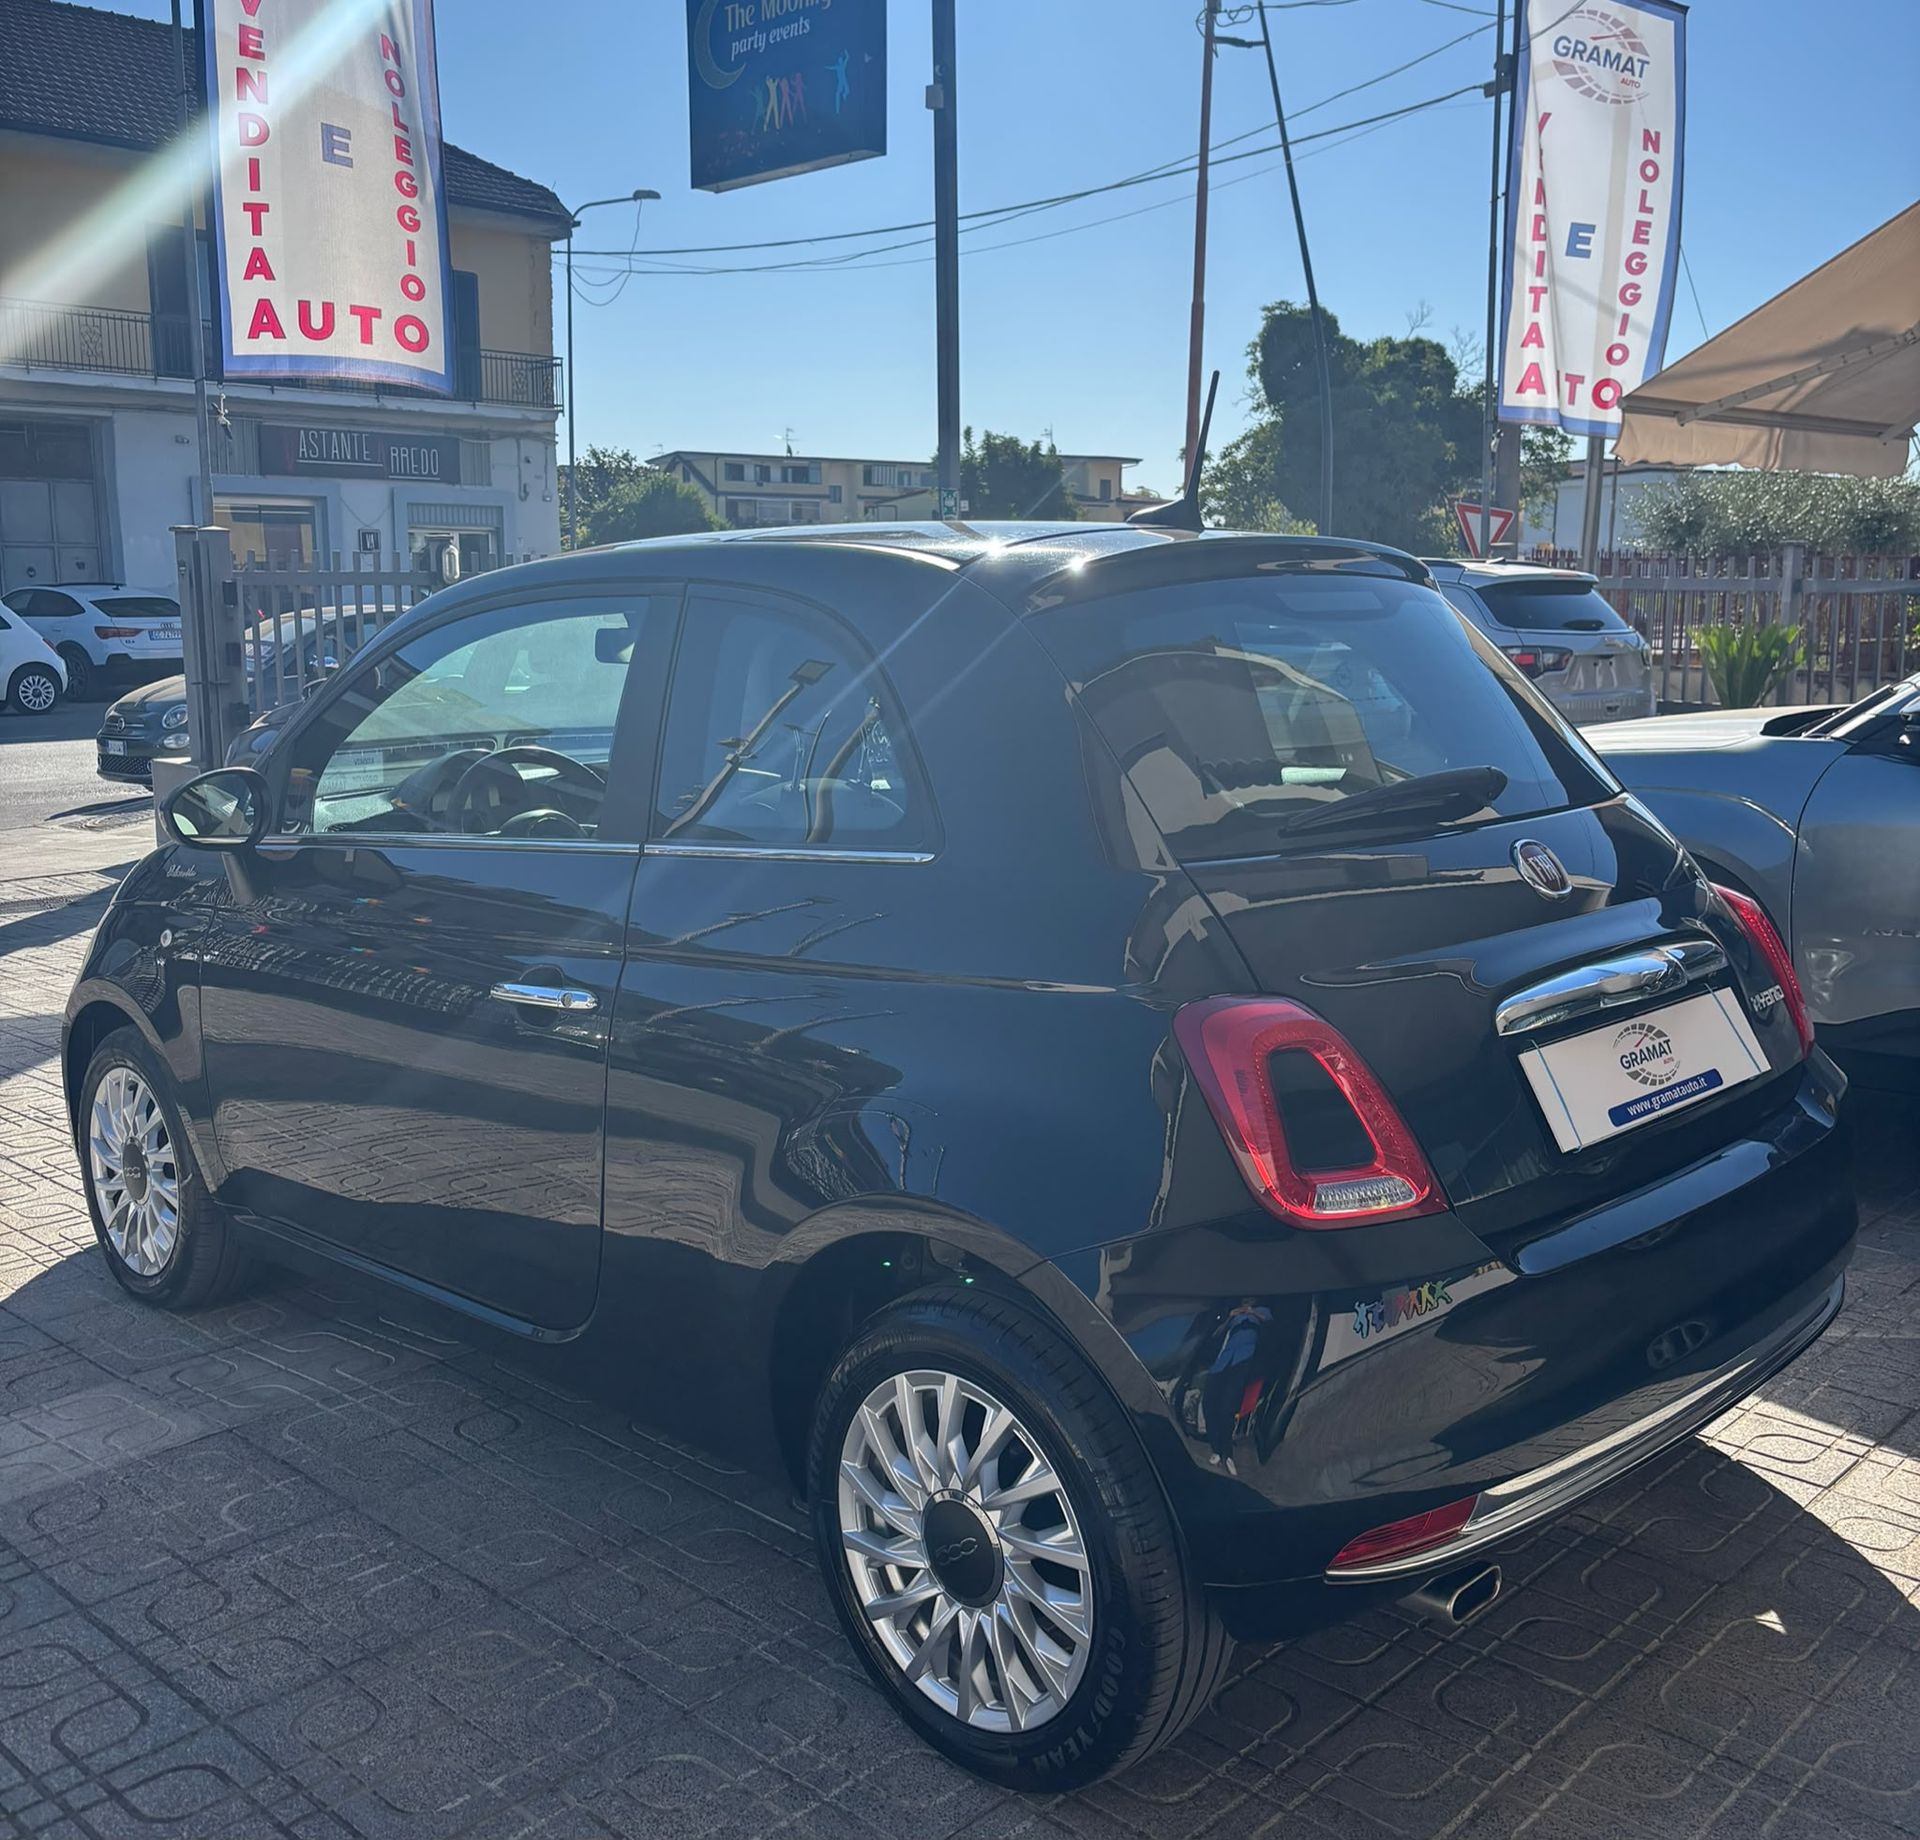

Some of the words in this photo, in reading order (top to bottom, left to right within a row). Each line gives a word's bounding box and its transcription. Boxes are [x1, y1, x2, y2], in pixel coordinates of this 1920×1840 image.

[724, 3, 755, 32] The
[731, 30, 767, 62] party
[769, 16, 811, 44] events
[1553, 35, 1650, 78] GRAMAT
[1620, 77, 1641, 89] AUTO
[320, 122, 353, 168] E
[381, 33, 426, 302] NOLEGGIO
[1565, 222, 1596, 259] E
[1605, 128, 1661, 366] NOLEGGIO
[247, 298, 430, 353] AUTO
[1516, 362, 1623, 410] ATO
[1620, 1039, 1673, 1070] GRAMAT
[1627, 1077, 1708, 1116] www.gramatauto.it
